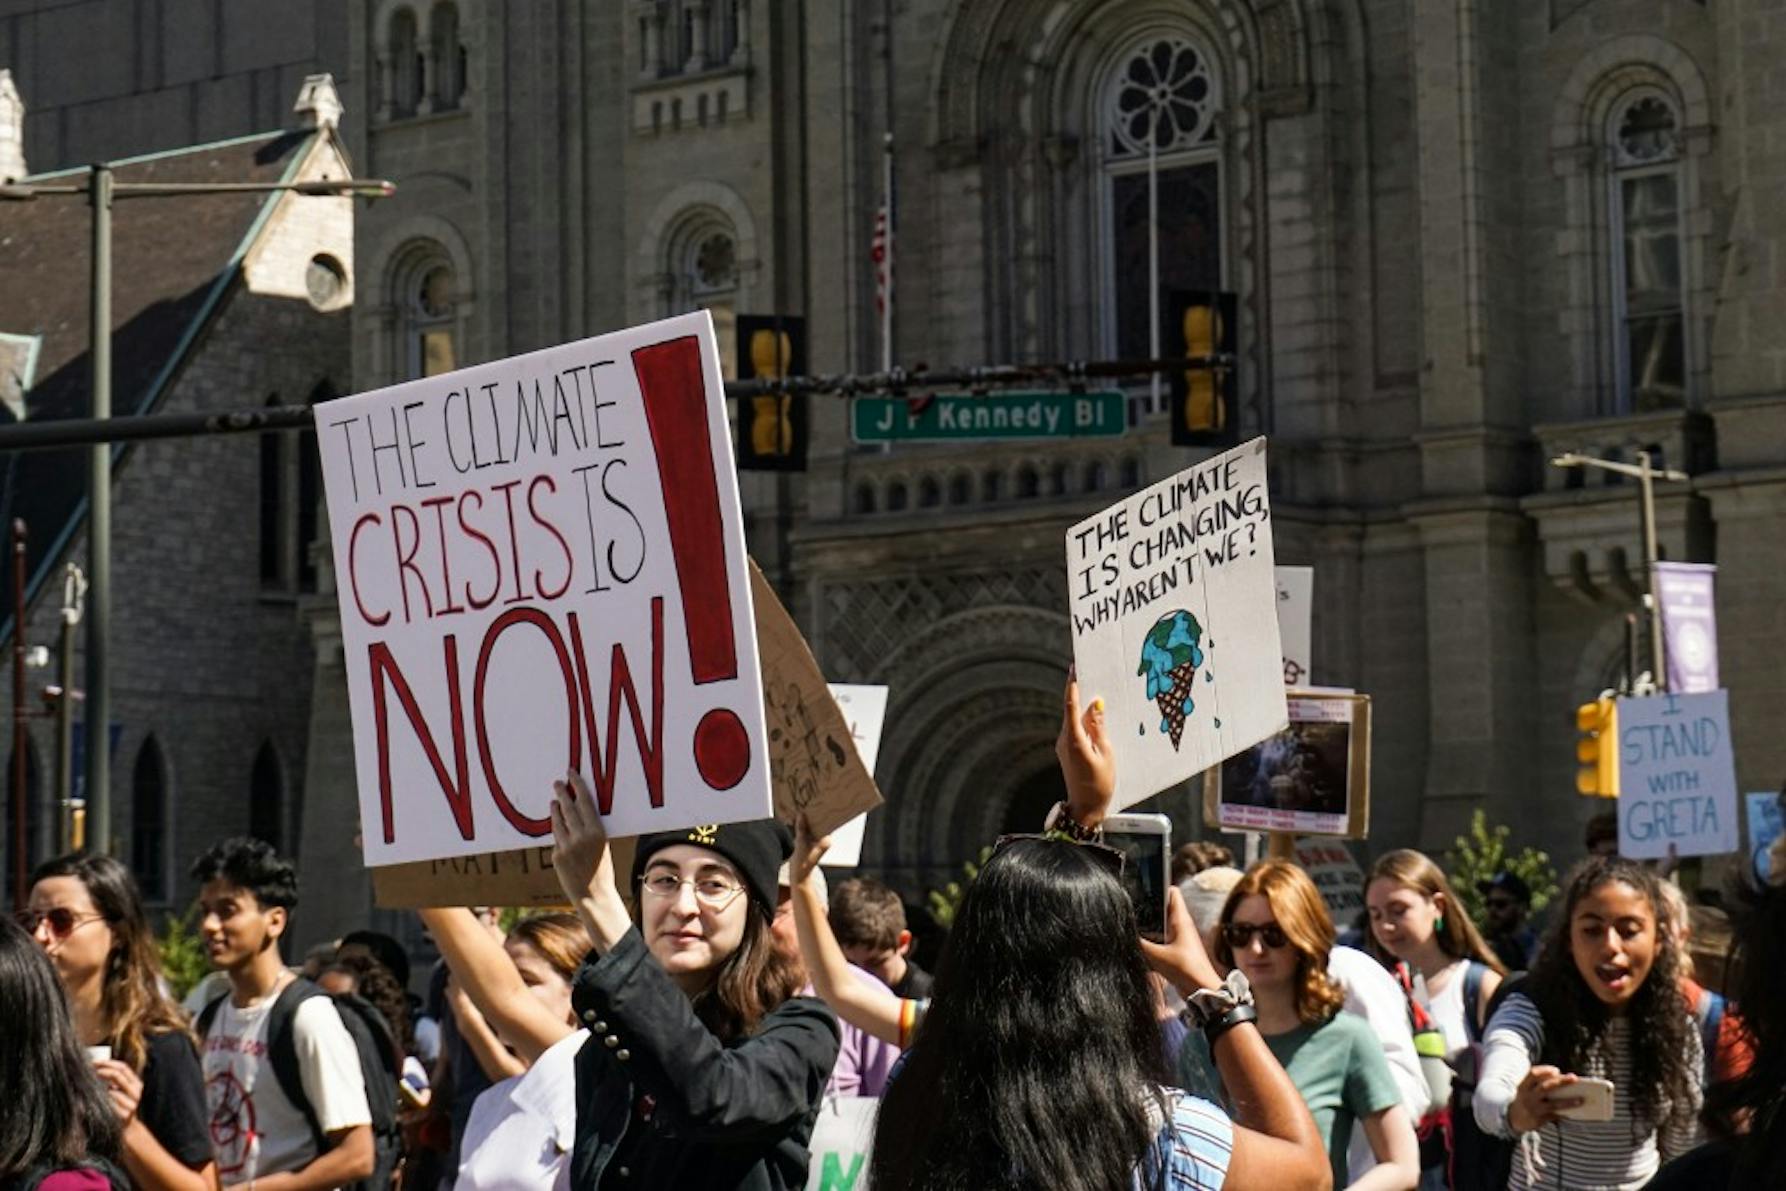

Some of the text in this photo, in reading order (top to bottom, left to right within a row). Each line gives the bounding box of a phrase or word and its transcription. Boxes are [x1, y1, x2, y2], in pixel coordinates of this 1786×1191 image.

[330, 360, 625, 502] THE CLIMATE
[876, 404, 894, 431] J
[938, 401, 1061, 432] Kennedy
[1075, 399, 1105, 426] Bl
[1075, 455, 1244, 560] THE CLIMATE
[348, 458, 646, 626] CRISIS IS
[1078, 484, 1269, 600] IS CHANGING,
[1662, 693, 1684, 716] I
[1623, 717, 1720, 765] STAND
[1647, 770, 1699, 795] WITH
[1625, 795, 1720, 842] GRETA
